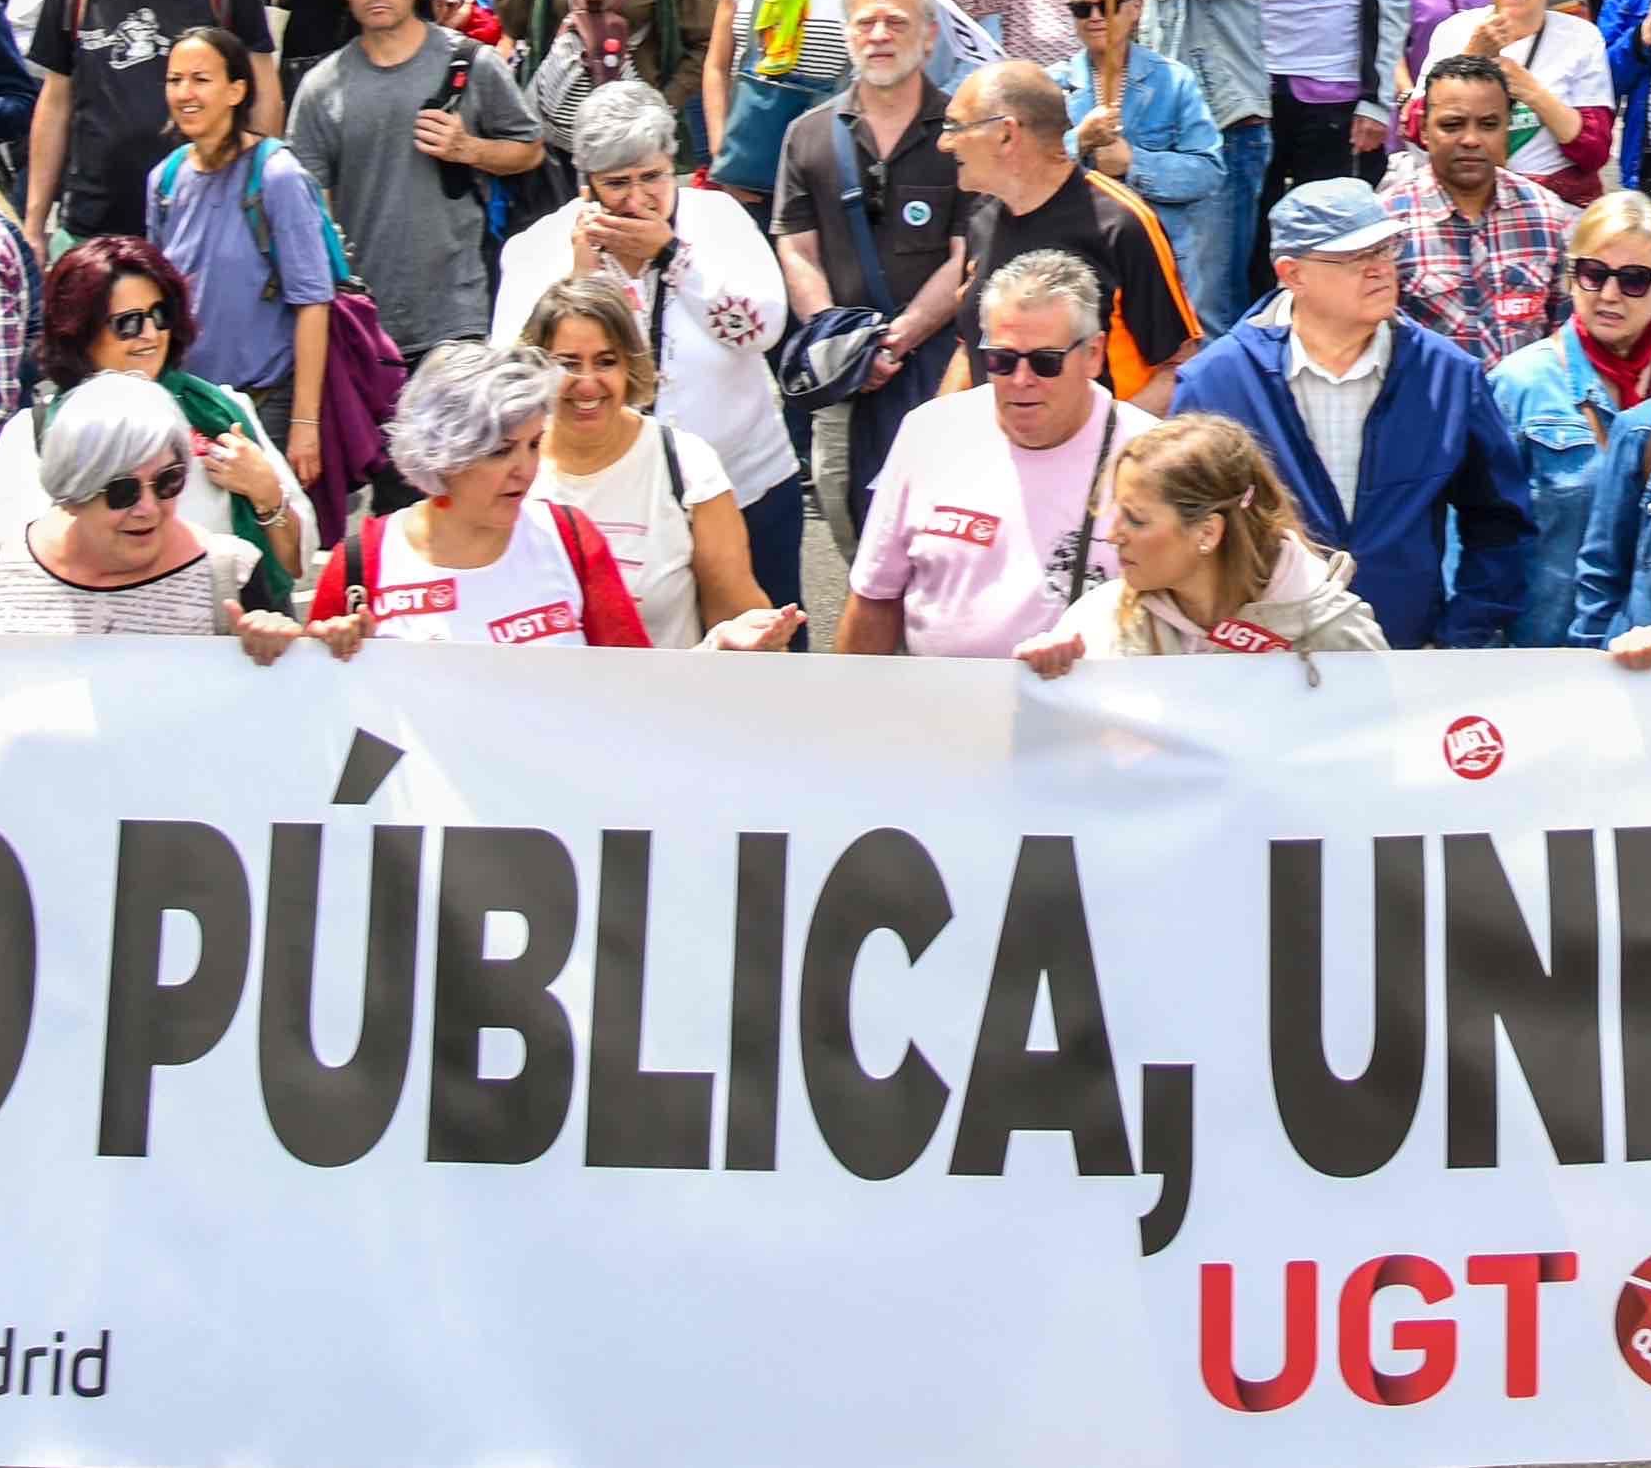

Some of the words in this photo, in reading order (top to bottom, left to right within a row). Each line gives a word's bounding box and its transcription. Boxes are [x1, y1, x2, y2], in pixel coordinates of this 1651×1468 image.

[372, 587, 429, 617] UGT
[491, 612, 549, 644] UGT
[1212, 620, 1270, 653] UGT
[96, 726, 1196, 1257] PÚBLICA,
[1198, 1251, 1579, 1414] UGT
